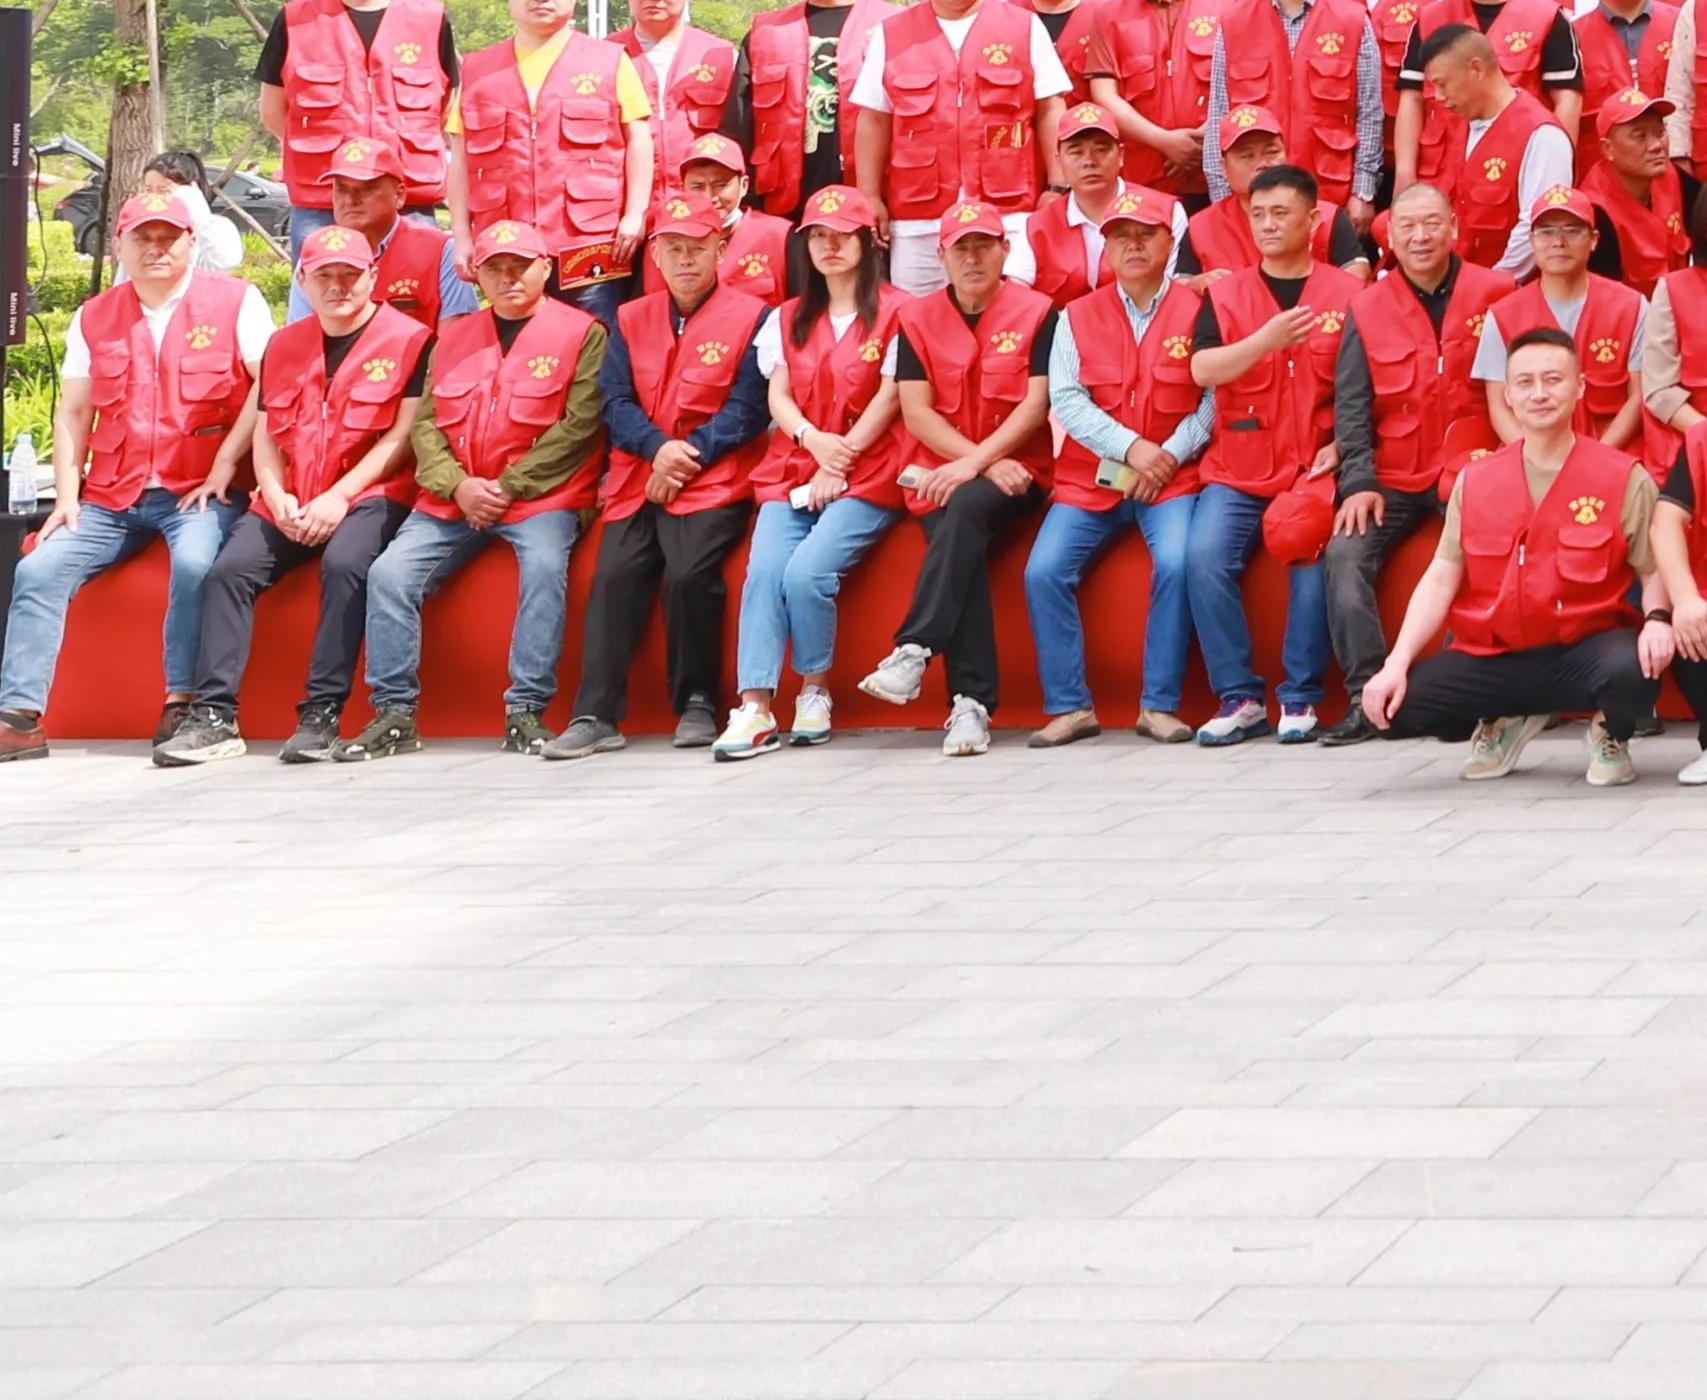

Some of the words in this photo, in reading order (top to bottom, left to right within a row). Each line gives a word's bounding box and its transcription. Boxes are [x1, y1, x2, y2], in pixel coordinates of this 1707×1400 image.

[13, 122, 21, 146] Mini
[12, 147, 20, 167] live
[10, 292, 18, 315] Mini
[9, 316, 17, 336] live
